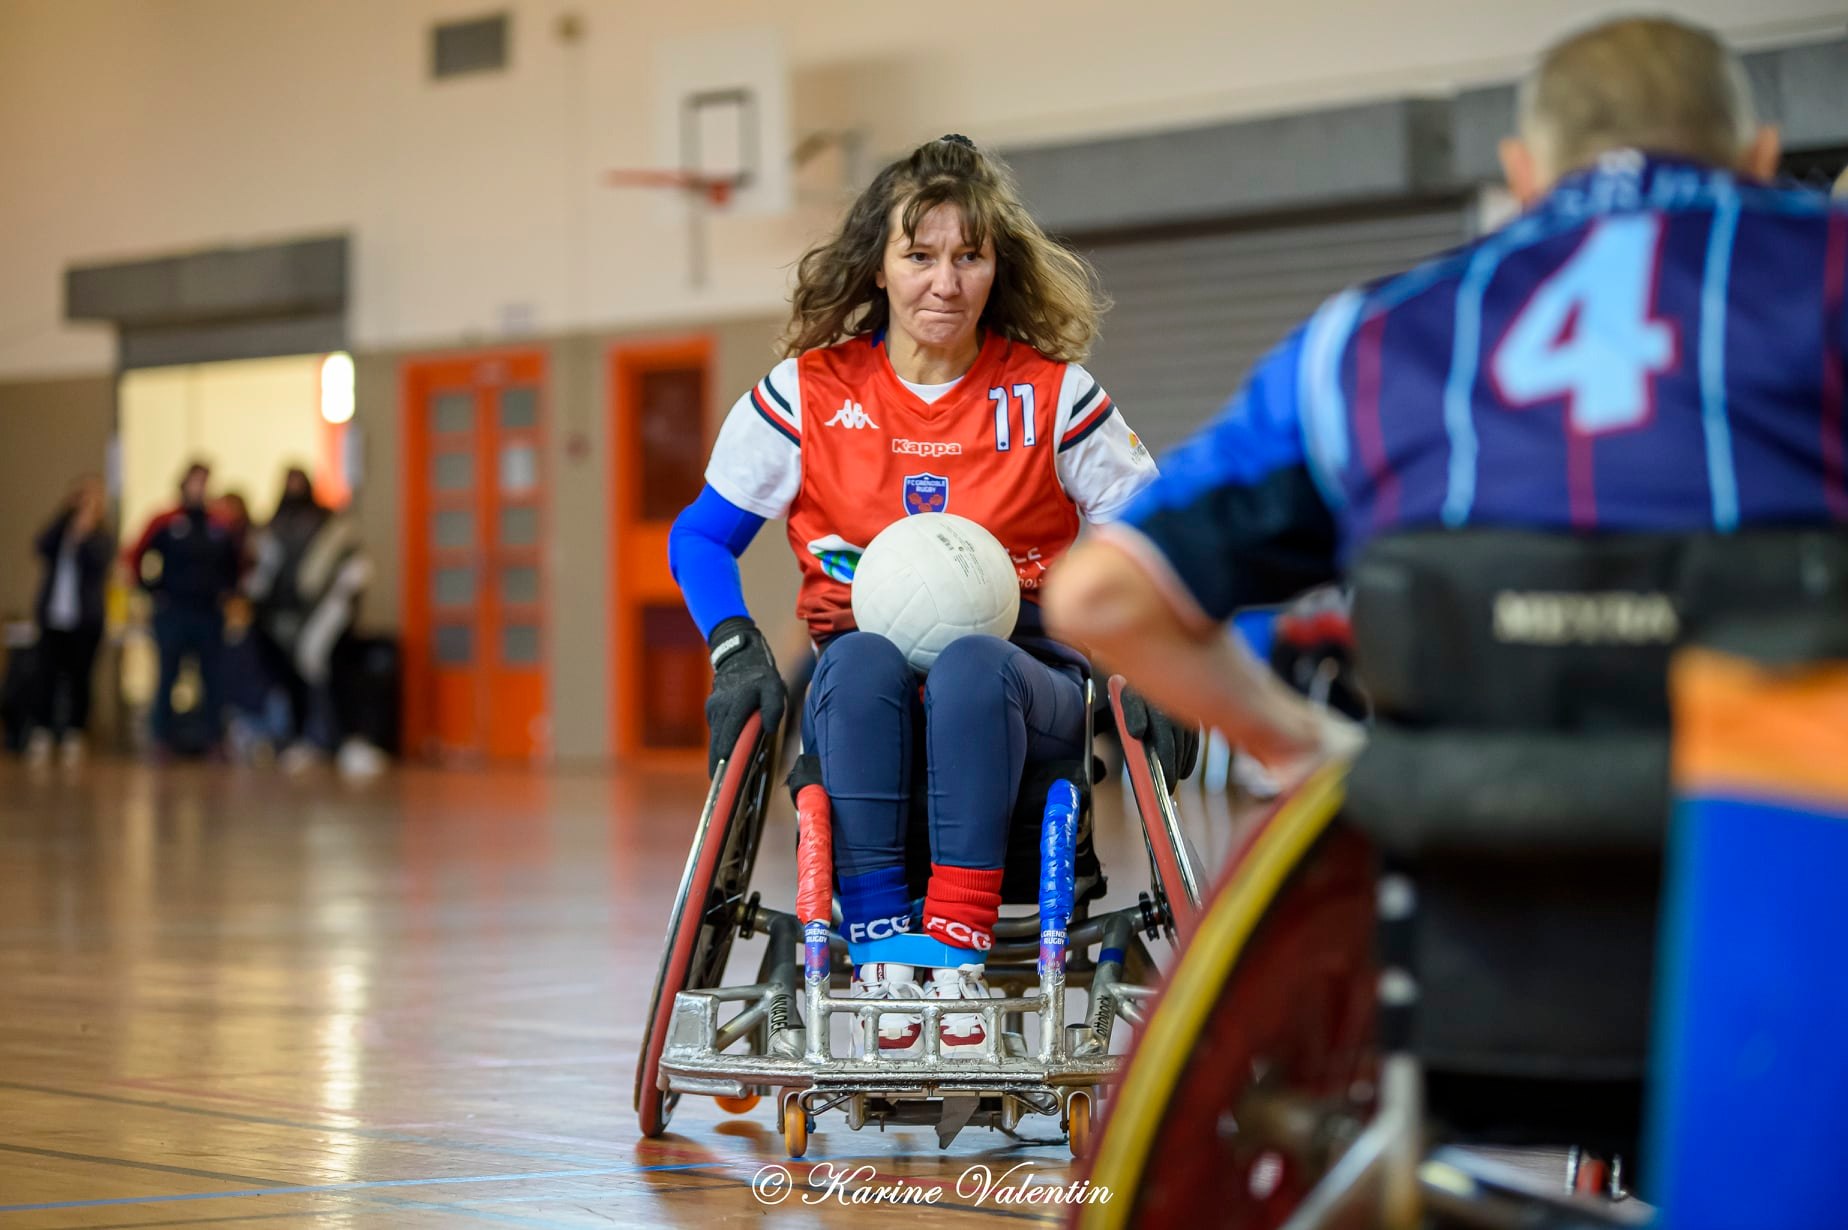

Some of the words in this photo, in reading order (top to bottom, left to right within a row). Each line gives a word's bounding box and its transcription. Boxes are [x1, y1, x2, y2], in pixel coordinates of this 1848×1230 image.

[1493, 211, 1680, 434] 4
[988, 383, 1036, 452] 11
[892, 439, 962, 457] Kappa
[850, 915, 910, 943] FCG
[927, 917, 991, 951] FCG
